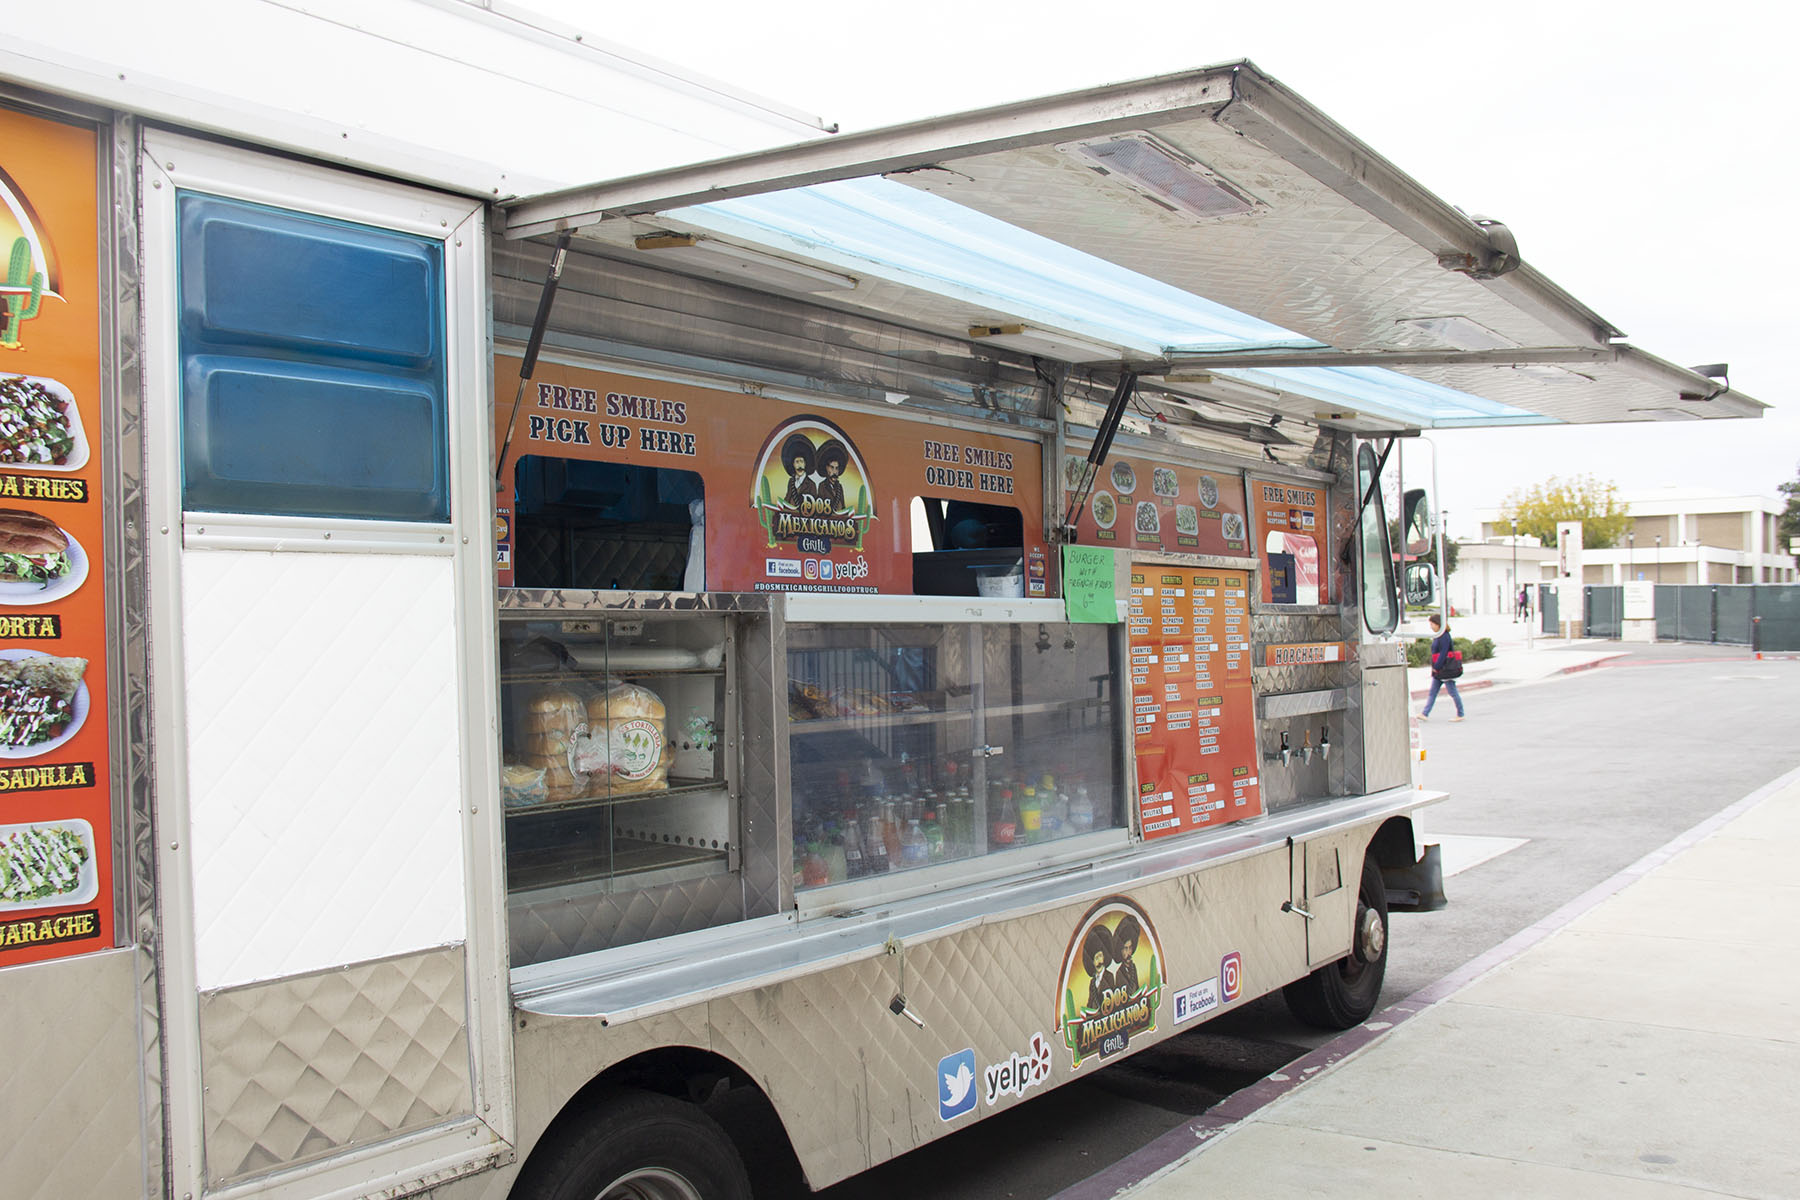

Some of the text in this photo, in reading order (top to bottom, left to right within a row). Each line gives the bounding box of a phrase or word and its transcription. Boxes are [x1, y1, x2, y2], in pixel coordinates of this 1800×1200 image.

[538, 384, 686, 424] FREE SMILES
[530, 416, 695, 455] PICK UP HERE
[924, 441, 1013, 470] FREE SMILES
[23, 477, 83, 499] FRIES
[927, 466, 1013, 494] ORDER HERE
[1263, 487, 1315, 506] FREE SMILES
[777, 513, 855, 539] MEXICANOS
[836, 562, 857, 579] yelp
[1070, 551, 1105, 565] BURGER
[1276, 647, 1324, 664] HORCHATA
[631, 721, 661, 749] TORTILLERIA
[1081, 998, 1149, 1048] MEXICANOS
[988, 1058, 1030, 1100] yelp
